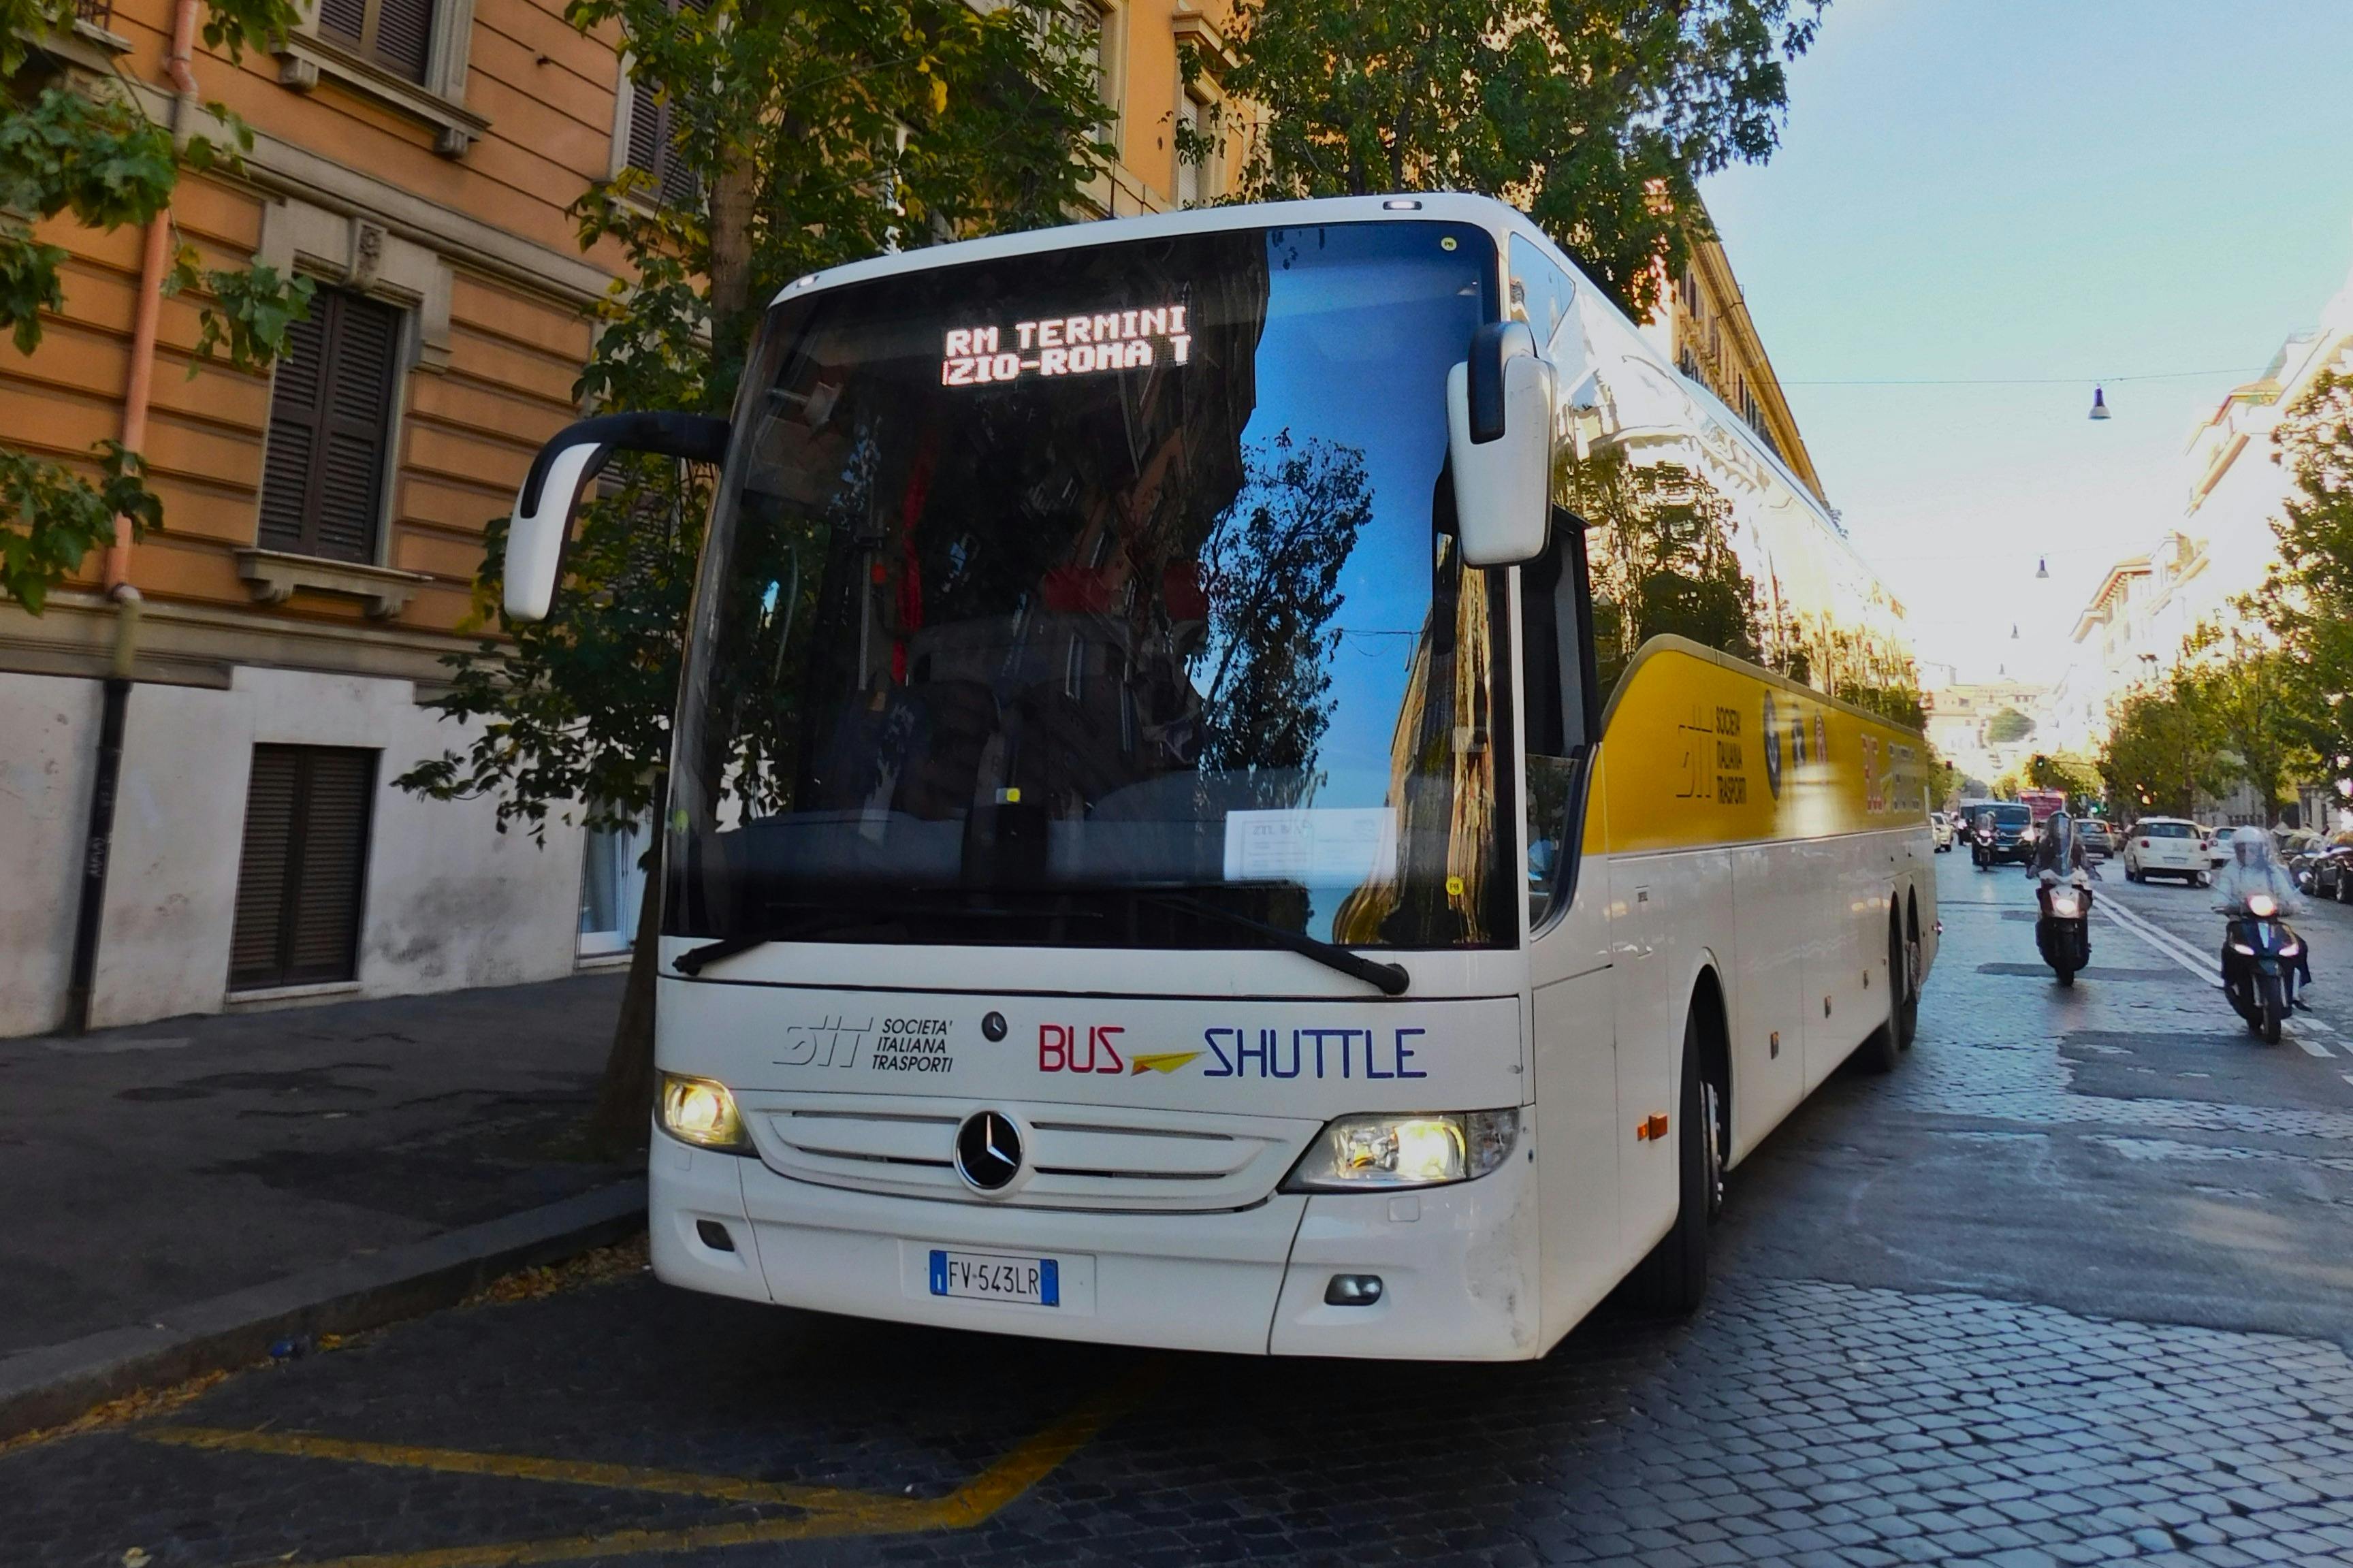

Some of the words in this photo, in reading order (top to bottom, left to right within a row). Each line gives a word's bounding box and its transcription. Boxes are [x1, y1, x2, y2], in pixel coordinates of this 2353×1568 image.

[946, 326, 999, 357] RM
[1015, 306, 1186, 349] TERMINI
[877, 1037, 946, 1053] ITALIANA
[1039, 1025, 1125, 1074] BUS
[1203, 1028, 1427, 1078] SHUTTLE
[872, 1055, 953, 1072] TRASPORTI
